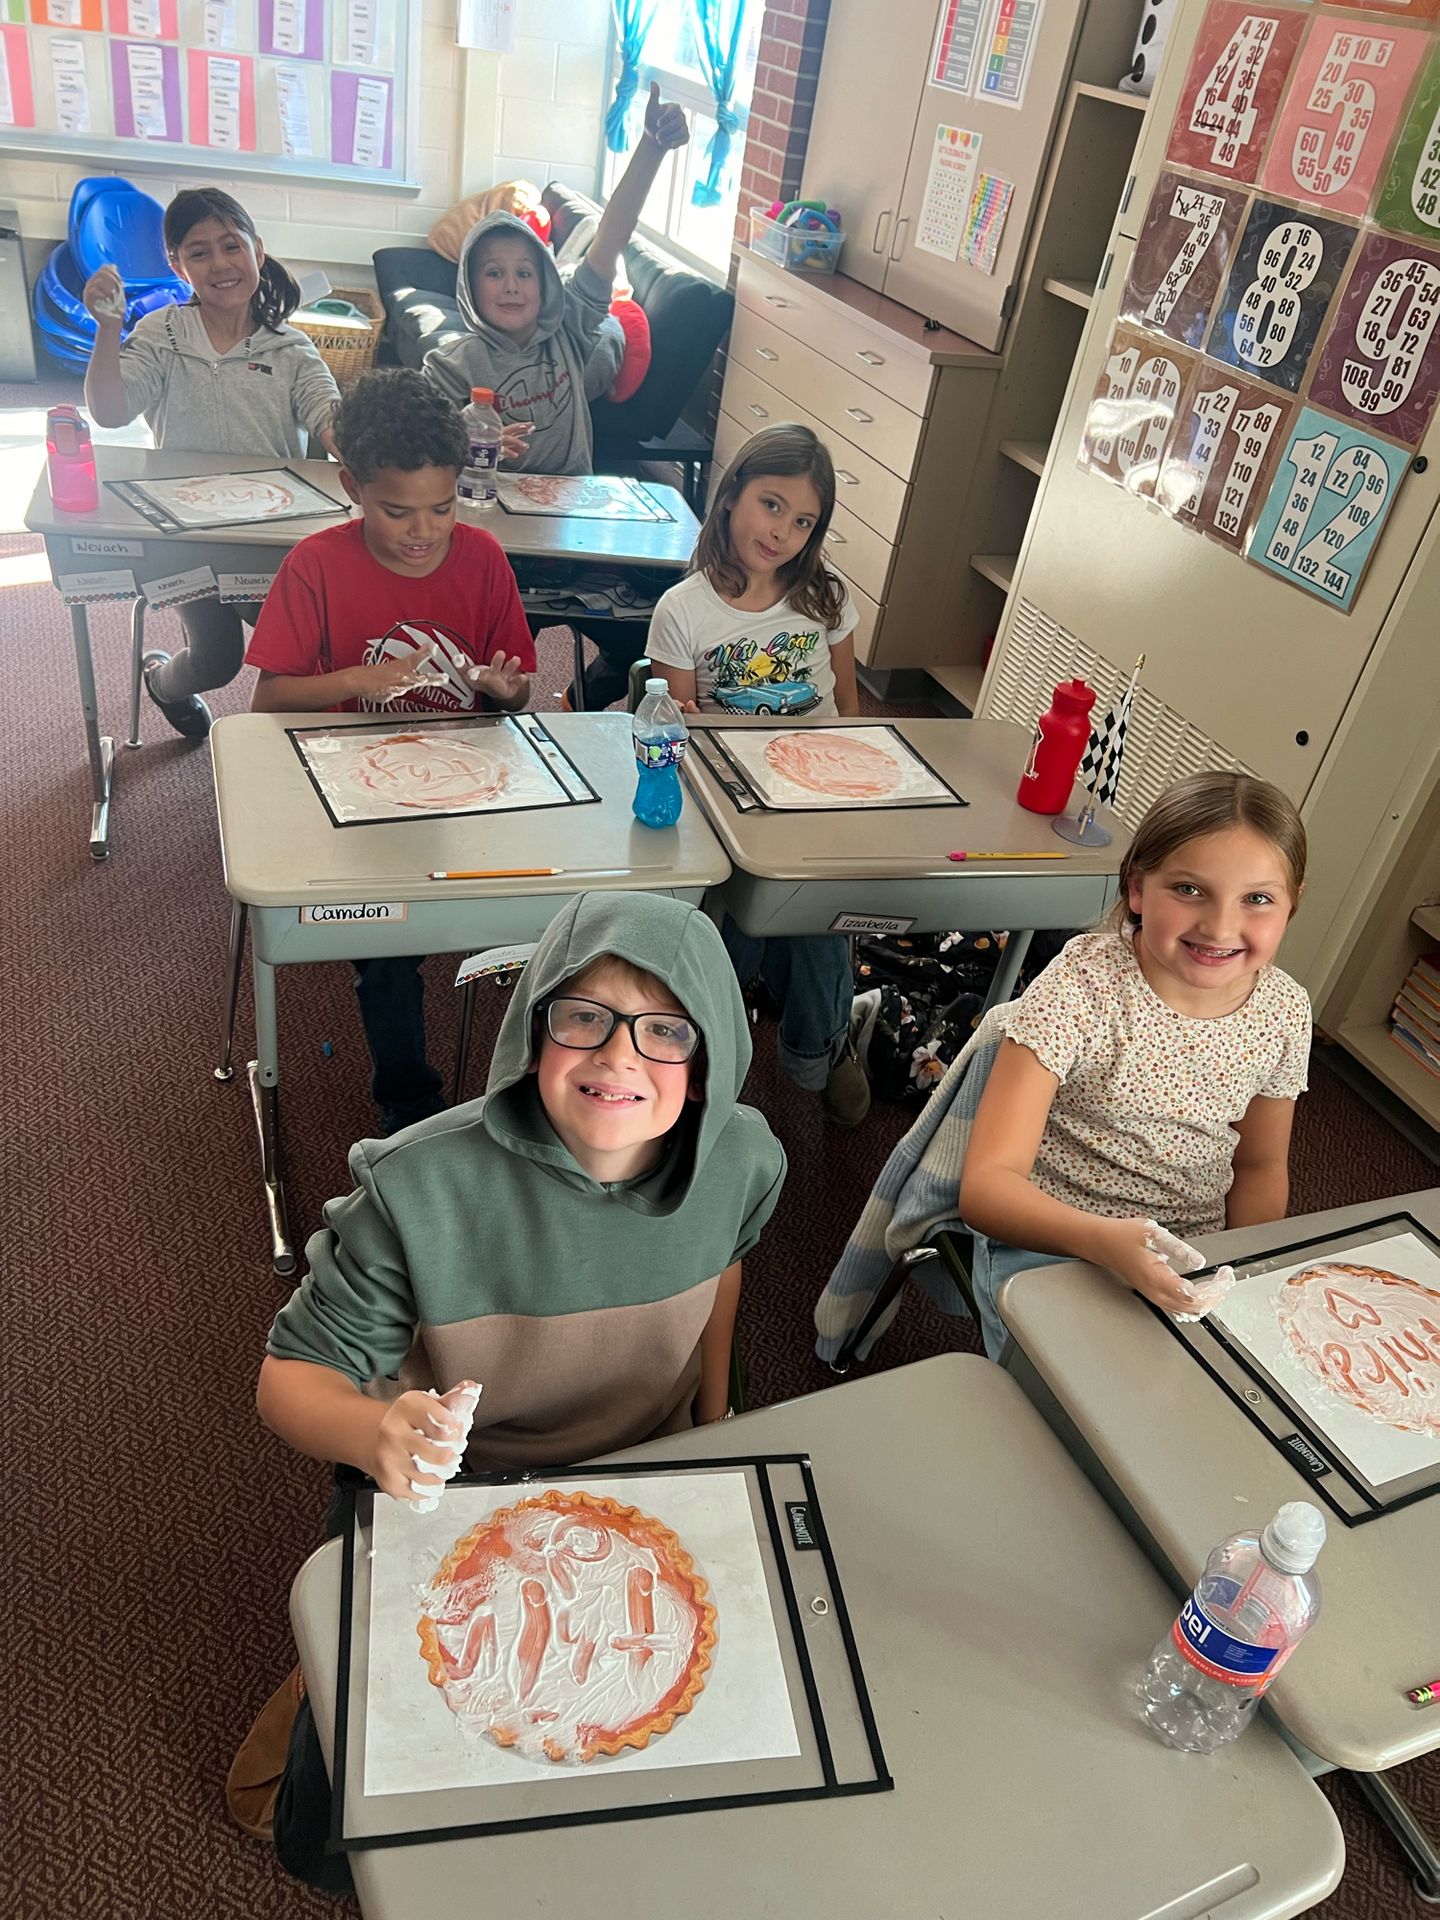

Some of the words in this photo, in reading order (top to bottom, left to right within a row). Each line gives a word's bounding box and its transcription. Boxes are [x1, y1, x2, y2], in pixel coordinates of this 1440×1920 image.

[1242, 20, 1252, 38] 4
[1255, 22, 1273, 40] 28
[1228, 42, 1239, 59] 8
[1246, 46, 1264, 65] 32
[1334, 36, 1352, 57] 15
[1353, 39, 1371, 60] 10
[1376, 43, 1389, 63] 5
[1217, 65, 1228, 83] 12
[1238, 70, 1256, 89] 36
[1322, 62, 1342, 83] 20
[1206, 87, 1217, 106] 16
[1312, 88, 1332, 109] 25
[1344, 82, 1364, 103] 30
[1232, 95, 1248, 114] 40
[1194, 109, 1209, 128] 20
[1209, 114, 1225, 132] 24
[1350, 108, 1371, 129] 35
[1226, 119, 1241, 138] 44
[1301, 132, 1319, 153] 60
[1336, 131, 1355, 151] 40
[1219, 143, 1235, 162] 48
[1298, 157, 1316, 178] 55
[1333, 155, 1352, 176] 45
[1314, 172, 1331, 193] 50
[1420, 167, 1440, 190] 42
[1193, 195, 1204, 210] 21
[1209, 200, 1222, 215] 28
[1416, 193, 1438, 216] 48
[1197, 214, 1211, 229] 35
[1196, 232, 1209, 247] 42
[1281, 228, 1291, 244] 8
[1297, 229, 1311, 247] 16
[1182, 242, 1196, 257] 49
[1264, 250, 1280, 267] 96
[1179, 260, 1193, 274] 56
[1298, 252, 1316, 271] 24
[1166, 272, 1177, 288] 63
[1285, 272, 1302, 290] 32
[1381, 270, 1403, 292] 36
[1405, 262, 1428, 284] 45
[1261, 275, 1277, 293] 40
[1246, 292, 1261, 309] 48
[1419, 283, 1440, 305] 54
[1154, 307, 1166, 323] 84
[1278, 298, 1295, 317] 88
[1371, 296, 1392, 317] 27
[1240, 314, 1254, 332] 56
[1408, 307, 1430, 330] 63
[1270, 324, 1286, 342] 80
[1363, 321, 1381, 341] 18
[1240, 338, 1254, 357] 64
[1374, 338, 1385, 357] 9
[1400, 332, 1419, 355] 72
[1258, 347, 1272, 364] 72
[1120, 357, 1131, 374] 10
[1152, 359, 1167, 376] 60
[1392, 357, 1411, 378] 81
[1343, 365, 1369, 388] 108
[1111, 385, 1123, 400] 20
[1137, 378, 1151, 395] 50
[1163, 380, 1176, 397] 70
[1382, 380, 1403, 402] 90
[1198, 397, 1210, 414] 11
[1213, 394, 1230, 413] 22
[1359, 389, 1381, 411] 99
[1204, 418, 1220, 438] 33
[1236, 413, 1250, 432] 77
[1253, 412, 1272, 432] 88
[1098, 438, 1110, 456] 40
[1120, 438, 1135, 456] 110
[1143, 444, 1157, 460] 90
[1196, 443, 1211, 462] 44
[1244, 437, 1262, 458] 99
[1311, 443, 1326, 461] 12
[1353, 450, 1371, 469] 84
[1232, 461, 1252, 483] 110
[1300, 468, 1317, 488] 24
[1332, 470, 1349, 489] 72
[1366, 475, 1384, 495] 96
[1224, 486, 1244, 508] 121
[1292, 493, 1309, 512] 36
[1218, 511, 1238, 533] 132
[1348, 504, 1370, 527] 108
[1283, 519, 1299, 536] 48
[1323, 528, 1345, 550] 120
[1273, 542, 1289, 561] 60
[1298, 556, 1319, 578] 132
[1323, 570, 1344, 591] 144
[704, 637, 758, 667] West
[761, 631, 820, 657] Coast
[311, 902, 389, 922] Camdon
[842, 918, 899, 930] Izzabella
